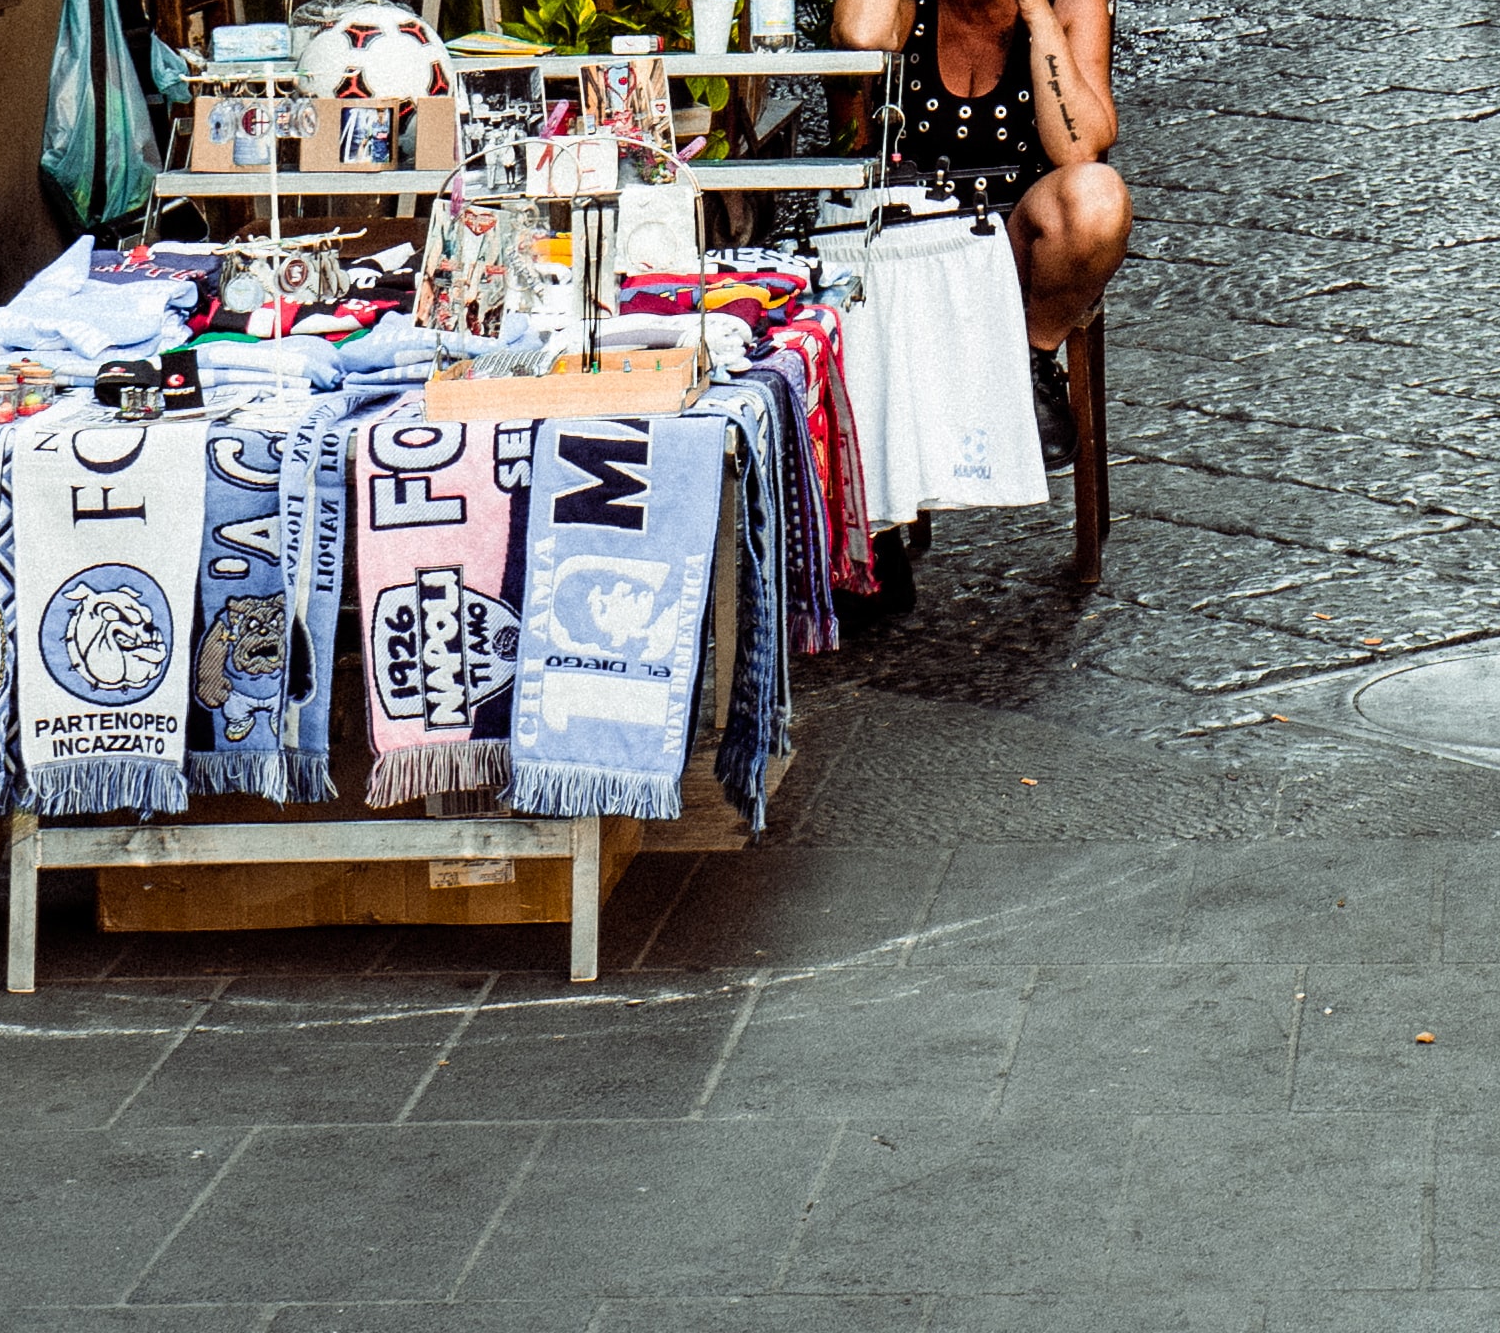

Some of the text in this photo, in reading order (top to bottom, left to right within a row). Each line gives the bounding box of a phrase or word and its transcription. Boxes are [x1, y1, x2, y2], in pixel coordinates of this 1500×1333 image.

[384, 604, 418, 701] 1926
[420, 570, 466, 726] NAPOLI
[516, 535, 557, 749] CHI AMA
[35, 712, 178, 738] PARTENOPEO
[53, 734, 165, 757] INCAZZATO
